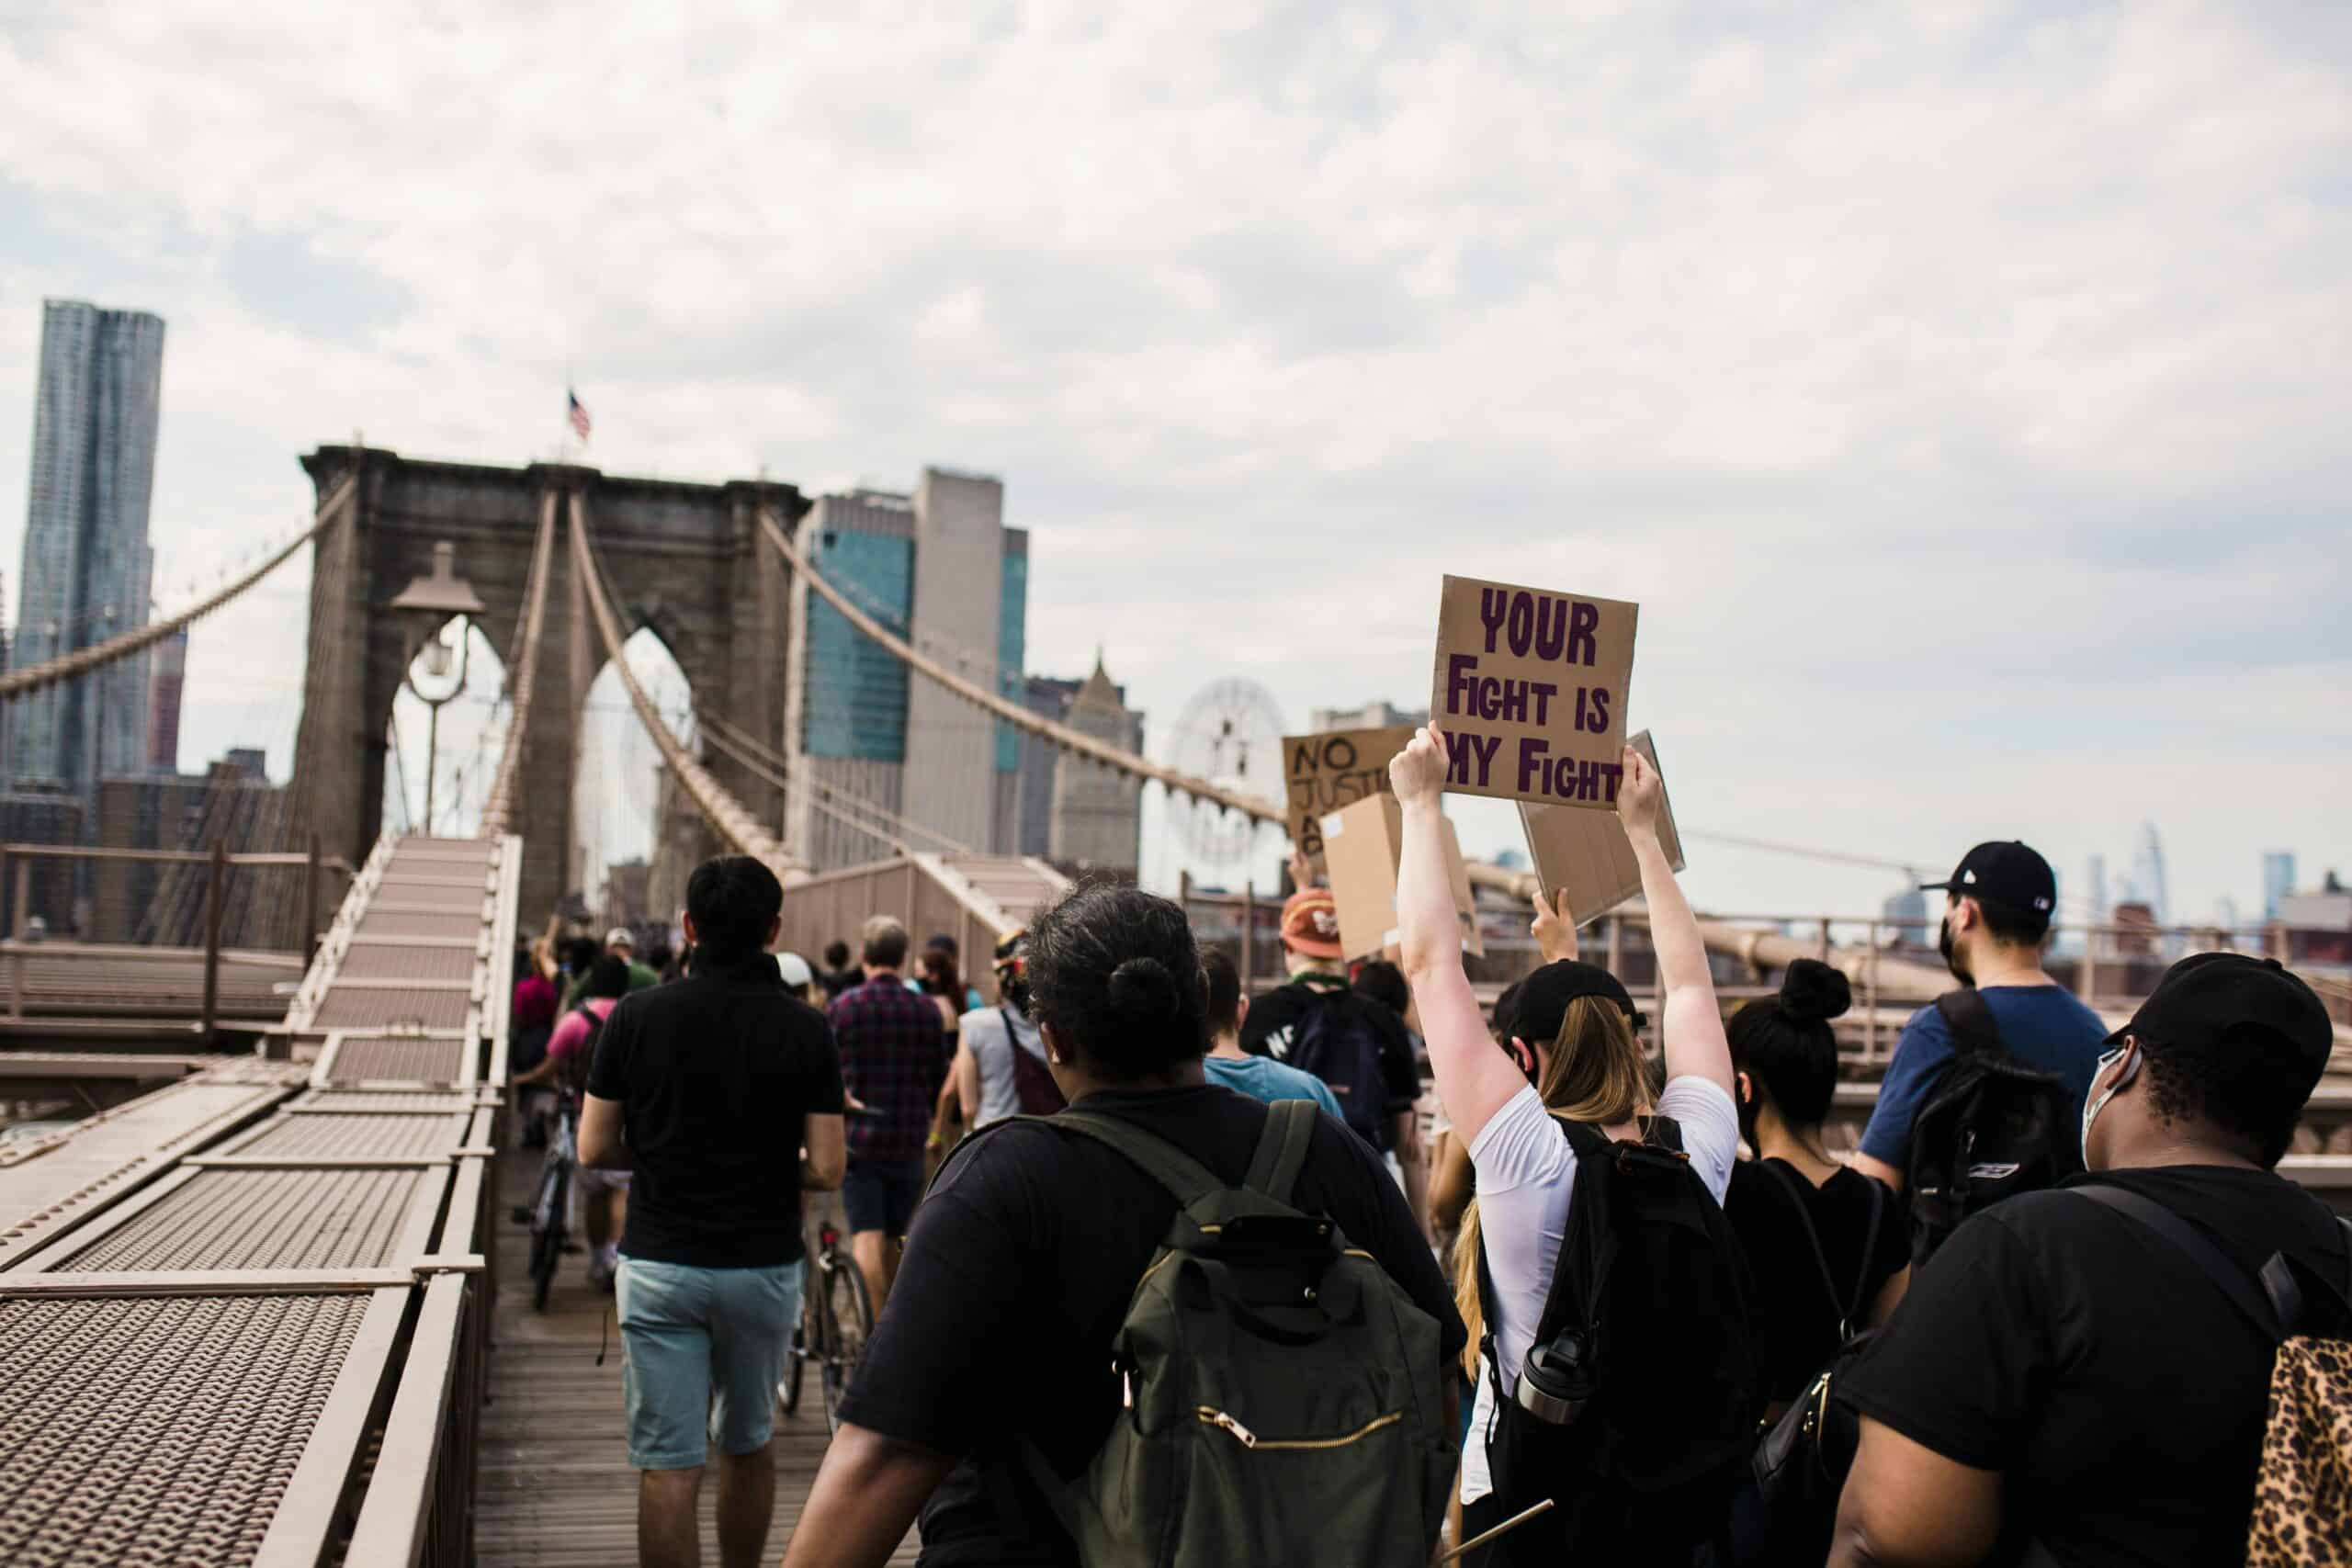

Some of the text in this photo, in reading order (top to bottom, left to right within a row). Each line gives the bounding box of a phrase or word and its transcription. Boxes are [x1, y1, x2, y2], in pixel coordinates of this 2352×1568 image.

[1481, 588, 1599, 667] YOUR
[1447, 653, 1610, 734] FIGHT IS
[1292, 767, 1391, 810] JUSTI
[1293, 738, 1357, 773] NO
[1442, 731, 1623, 802] MY FIGHT
